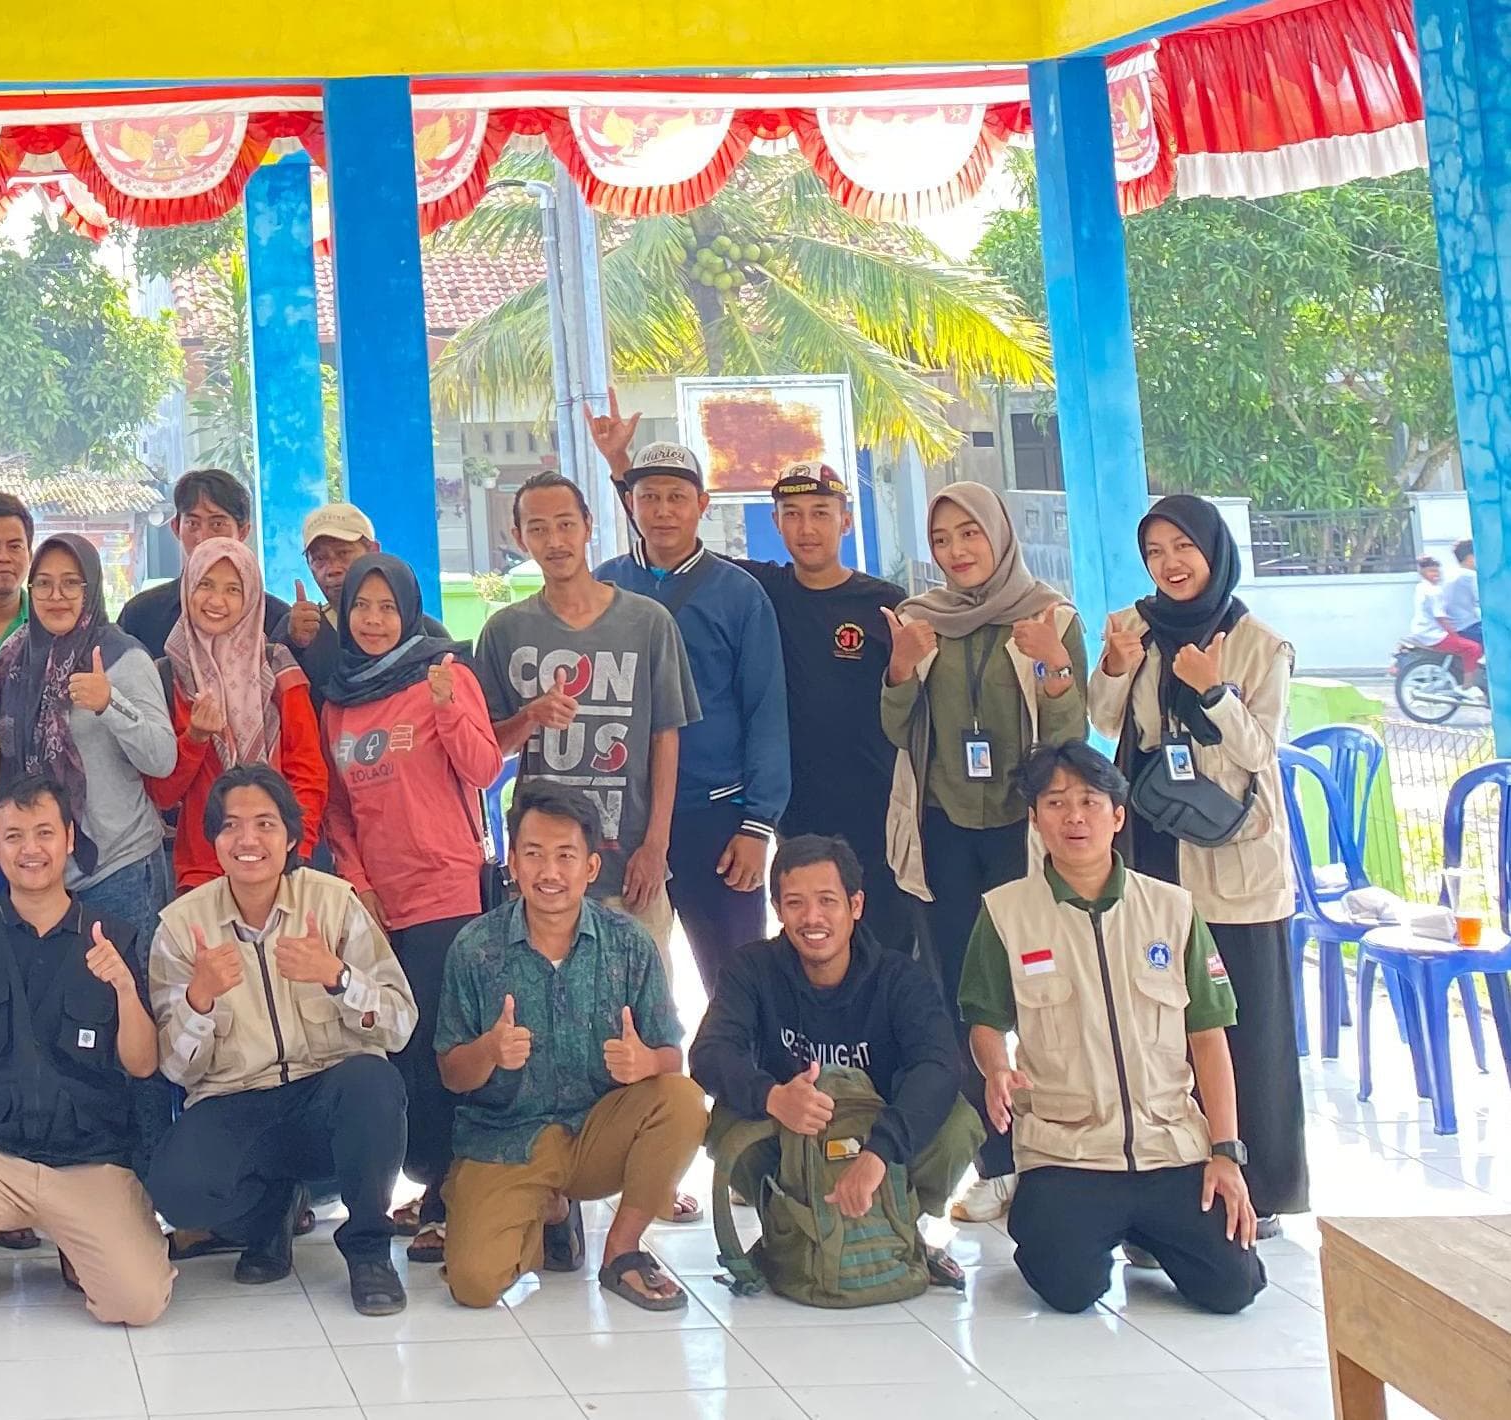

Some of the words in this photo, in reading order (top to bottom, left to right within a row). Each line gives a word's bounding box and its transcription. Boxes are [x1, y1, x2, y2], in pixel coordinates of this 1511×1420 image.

[642, 448, 685, 463] Hurley
[508, 646, 638, 702] CON
[528, 721, 629, 773] US
